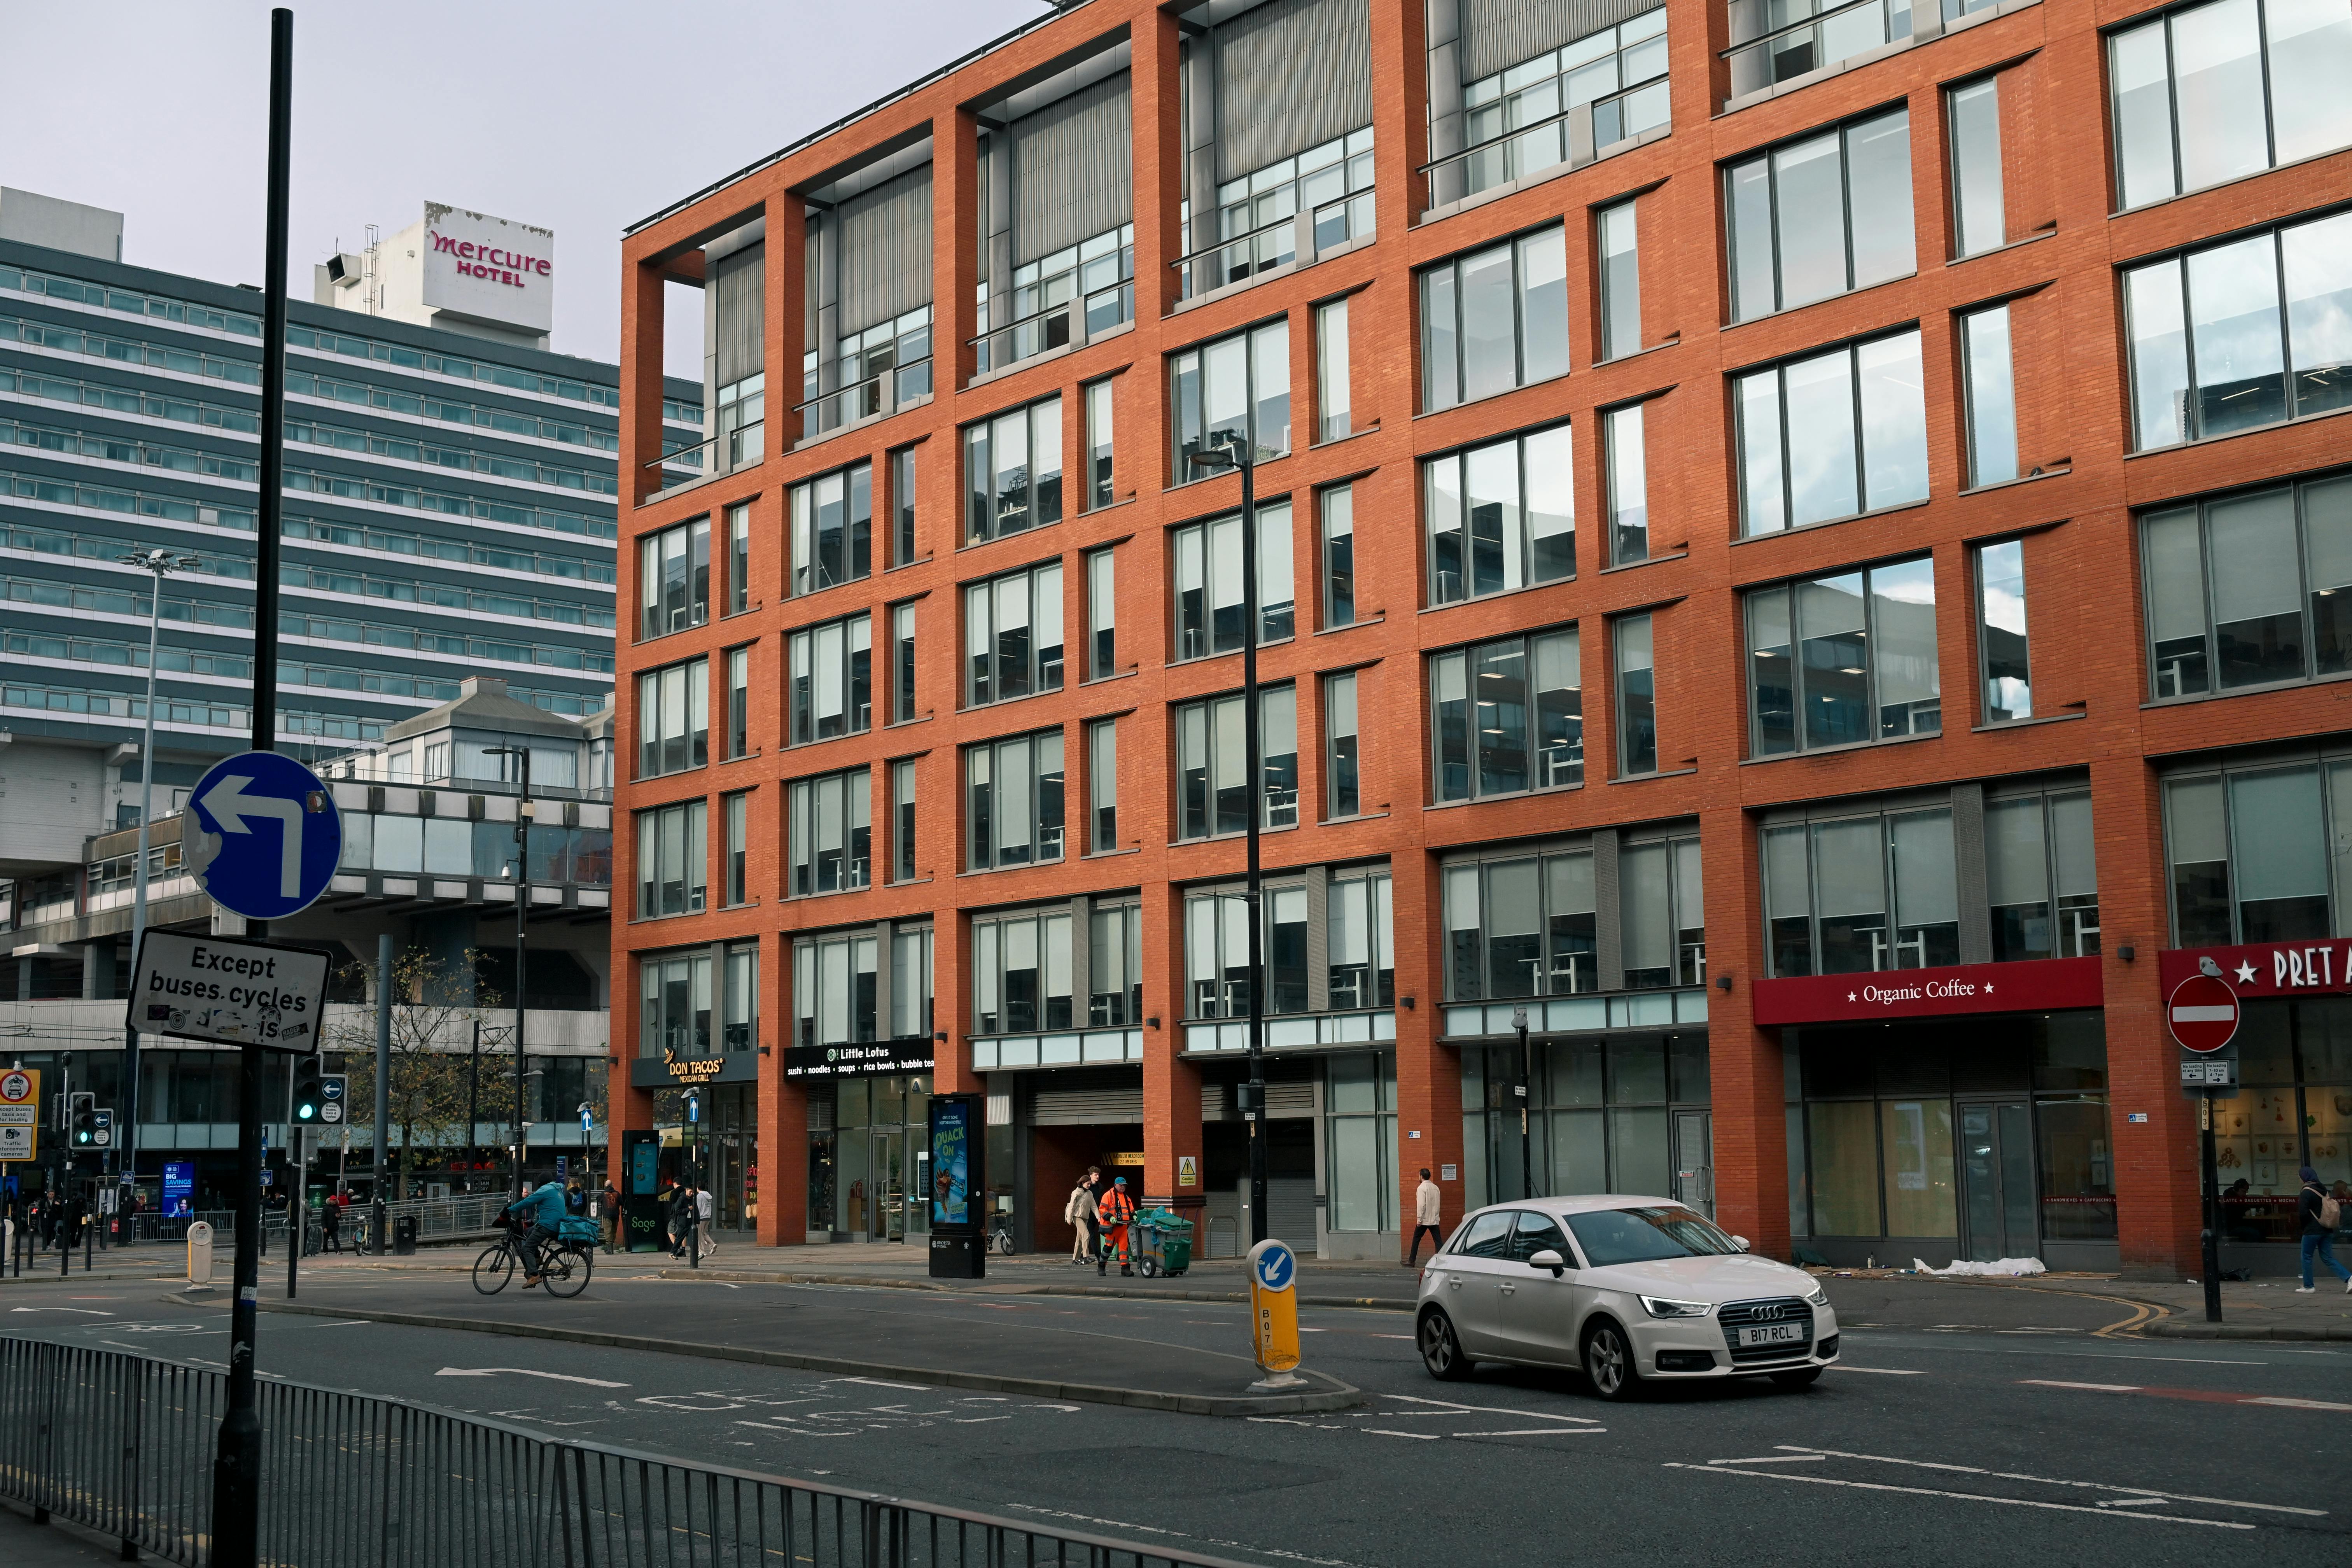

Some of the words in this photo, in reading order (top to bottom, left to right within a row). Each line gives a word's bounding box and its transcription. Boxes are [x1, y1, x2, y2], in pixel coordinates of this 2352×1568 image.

[457, 260, 525, 287] HOTEL
[191, 946, 276, 979] Except
[2274, 947, 2331, 987] PRET
[229, 987, 306, 1012] cycles
[1863, 983, 1922, 1005] Organic
[1926, 979, 1975, 998] Coffee
[841, 1048, 863, 1059] Little
[866, 1047, 889, 1058] Lotus
[670, 1062, 688, 1075] DON
[788, 1066, 802, 1075] sushi
[808, 1065, 831, 1074] noodles
[838, 1065, 855, 1074] soups
[864, 1062, 875, 1071] rice
[877, 1061, 895, 1070] bowls
[901, 1059, 922, 1068] bubble
[936, 1127, 964, 1149] QUACK
[943, 1145, 954, 1156] ON
[632, 1216, 655, 1232] Sage
[1771, 1326, 1793, 1340] RCL
